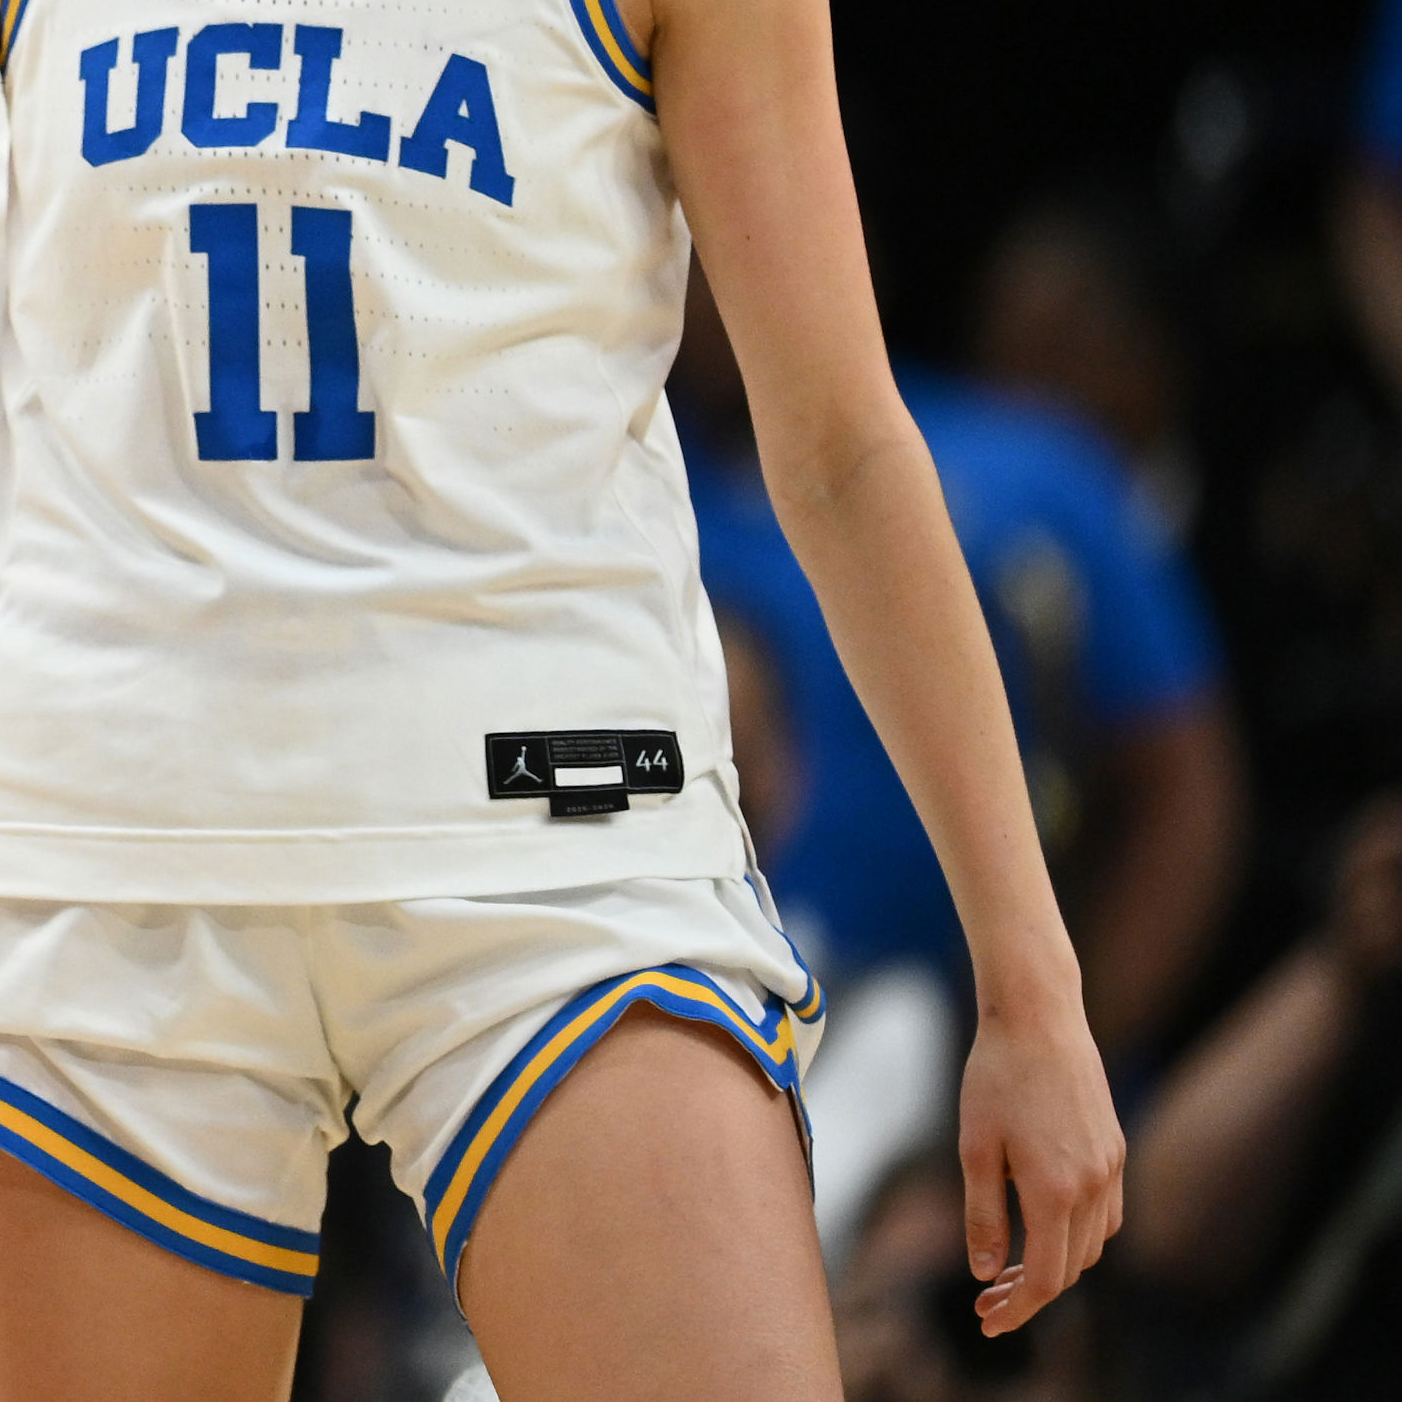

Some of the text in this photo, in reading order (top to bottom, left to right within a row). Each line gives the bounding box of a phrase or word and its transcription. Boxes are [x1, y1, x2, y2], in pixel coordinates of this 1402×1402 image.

[79, 22, 515, 207] UCLA
[189, 203, 376, 461] 11
[635, 749, 669, 772] 44
